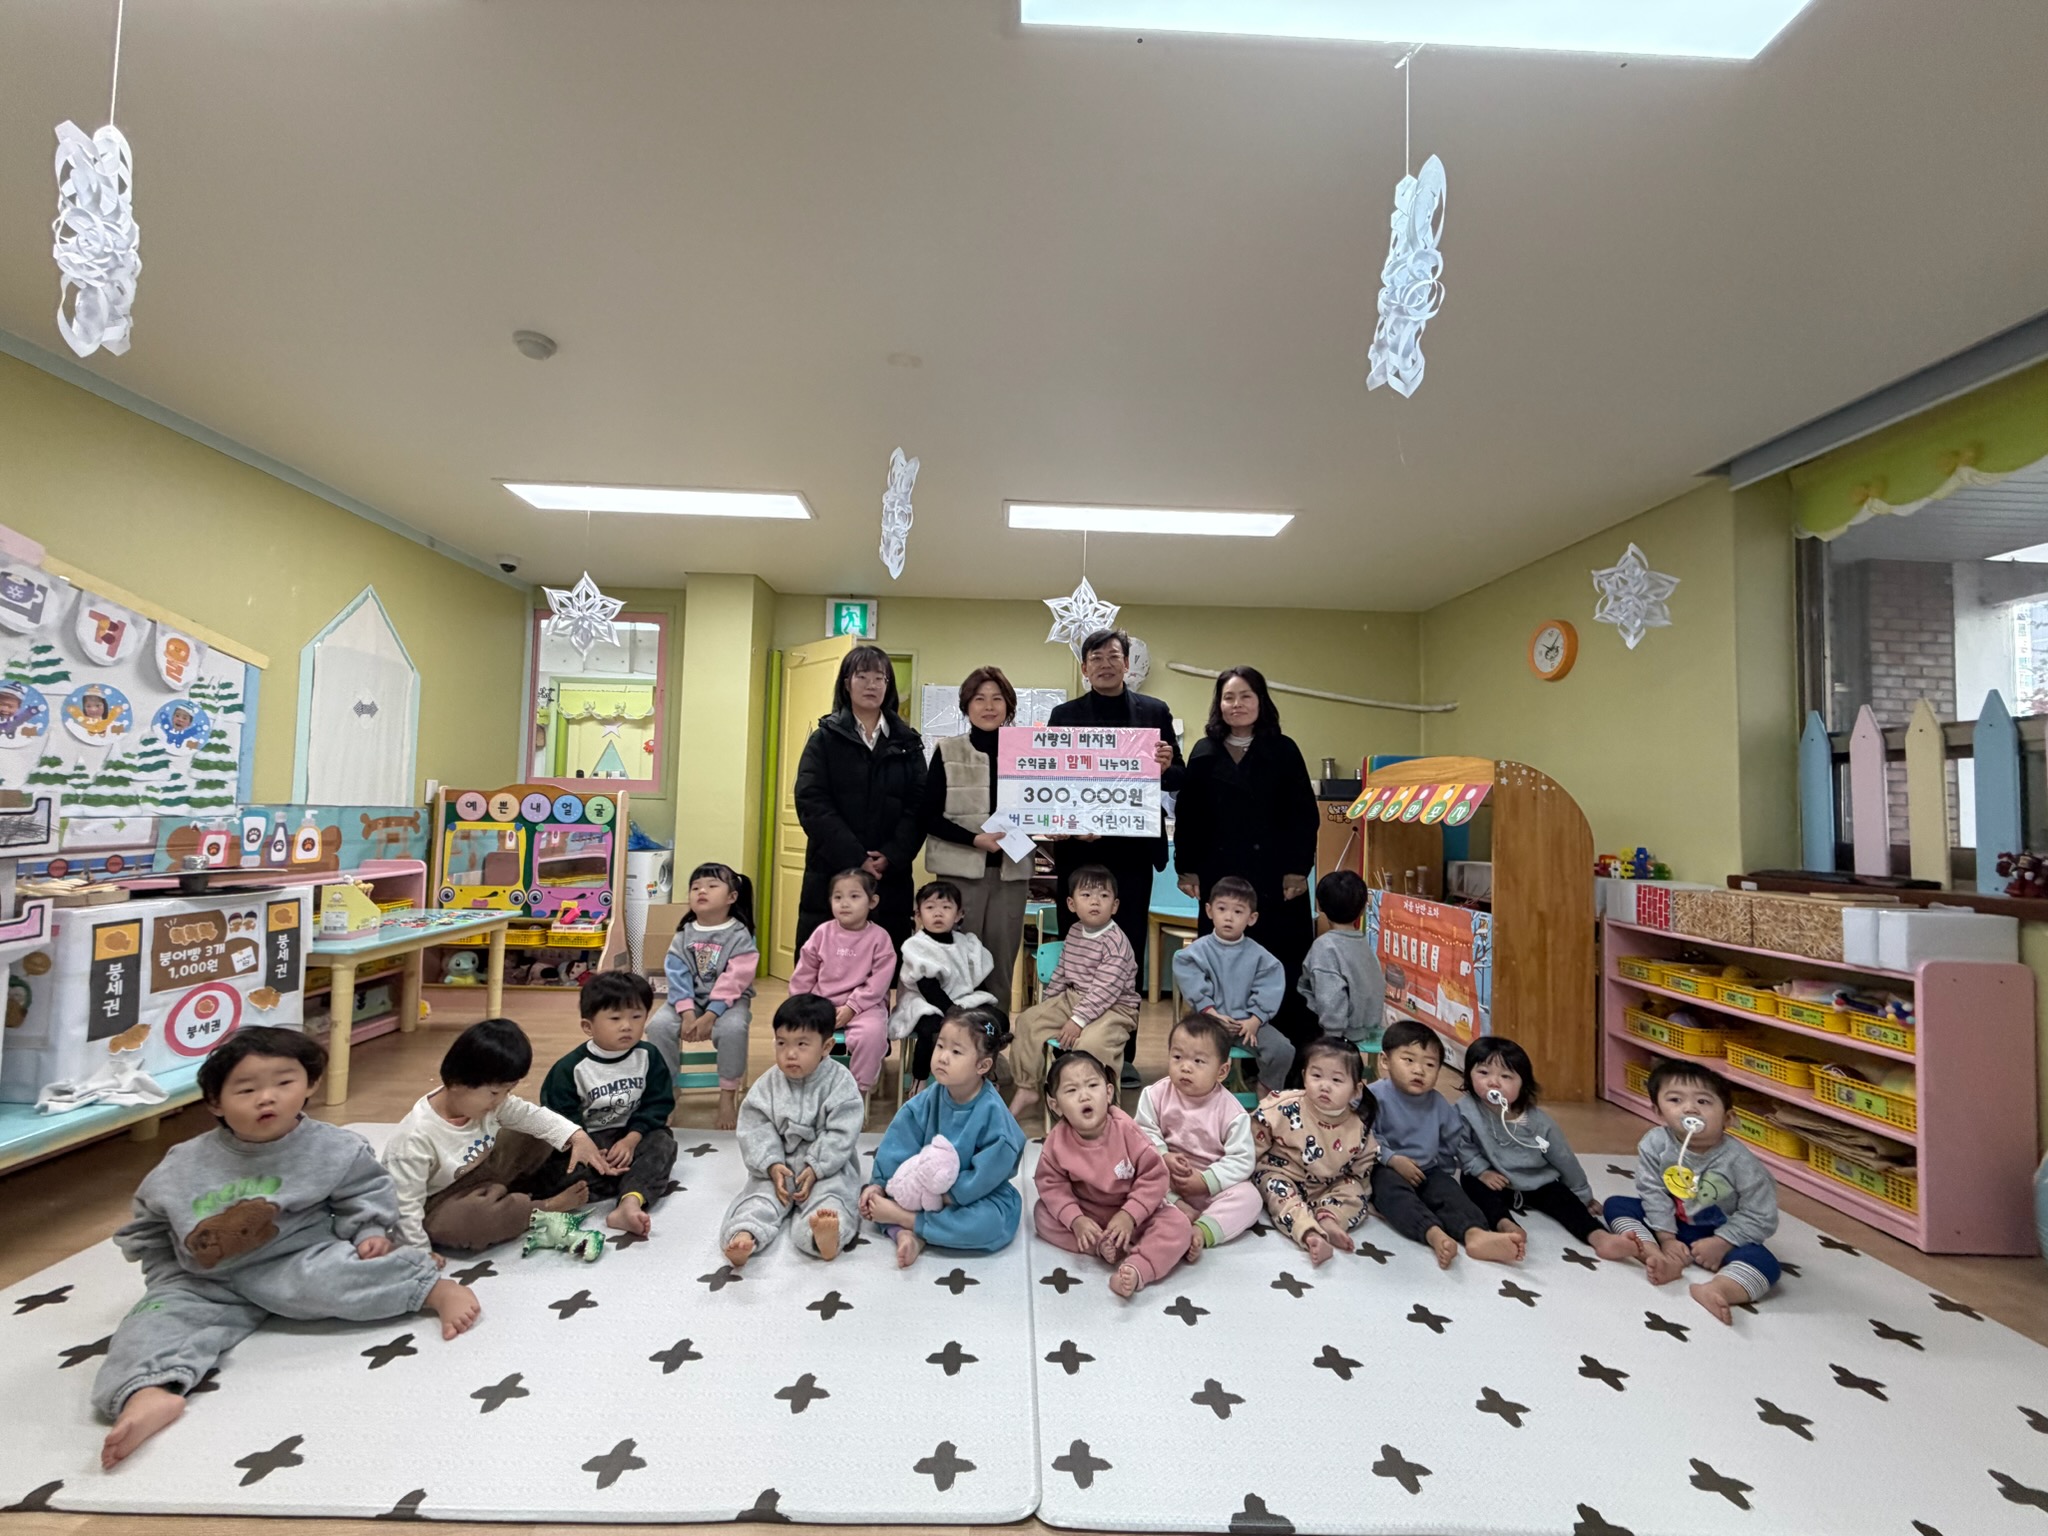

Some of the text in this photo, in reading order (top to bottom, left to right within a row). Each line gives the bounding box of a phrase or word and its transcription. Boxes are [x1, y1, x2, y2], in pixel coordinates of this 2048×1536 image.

[1034, 732, 1116, 748] 사랑의 바자회
[1017, 754, 1140, 771] 수익금을 함께 나누어요
[1023, 786, 1143, 807] 300,000원
[1008, 813, 1145, 830] 버드내마을 어린이집
[159, 942, 227, 967] 붕어빵 3개
[274, 933, 290, 980] 붕세권
[167, 958, 220, 980] 1,000원
[101, 962, 125, 1018] 붕세권
[186, 1018, 222, 1040] 붕세권
